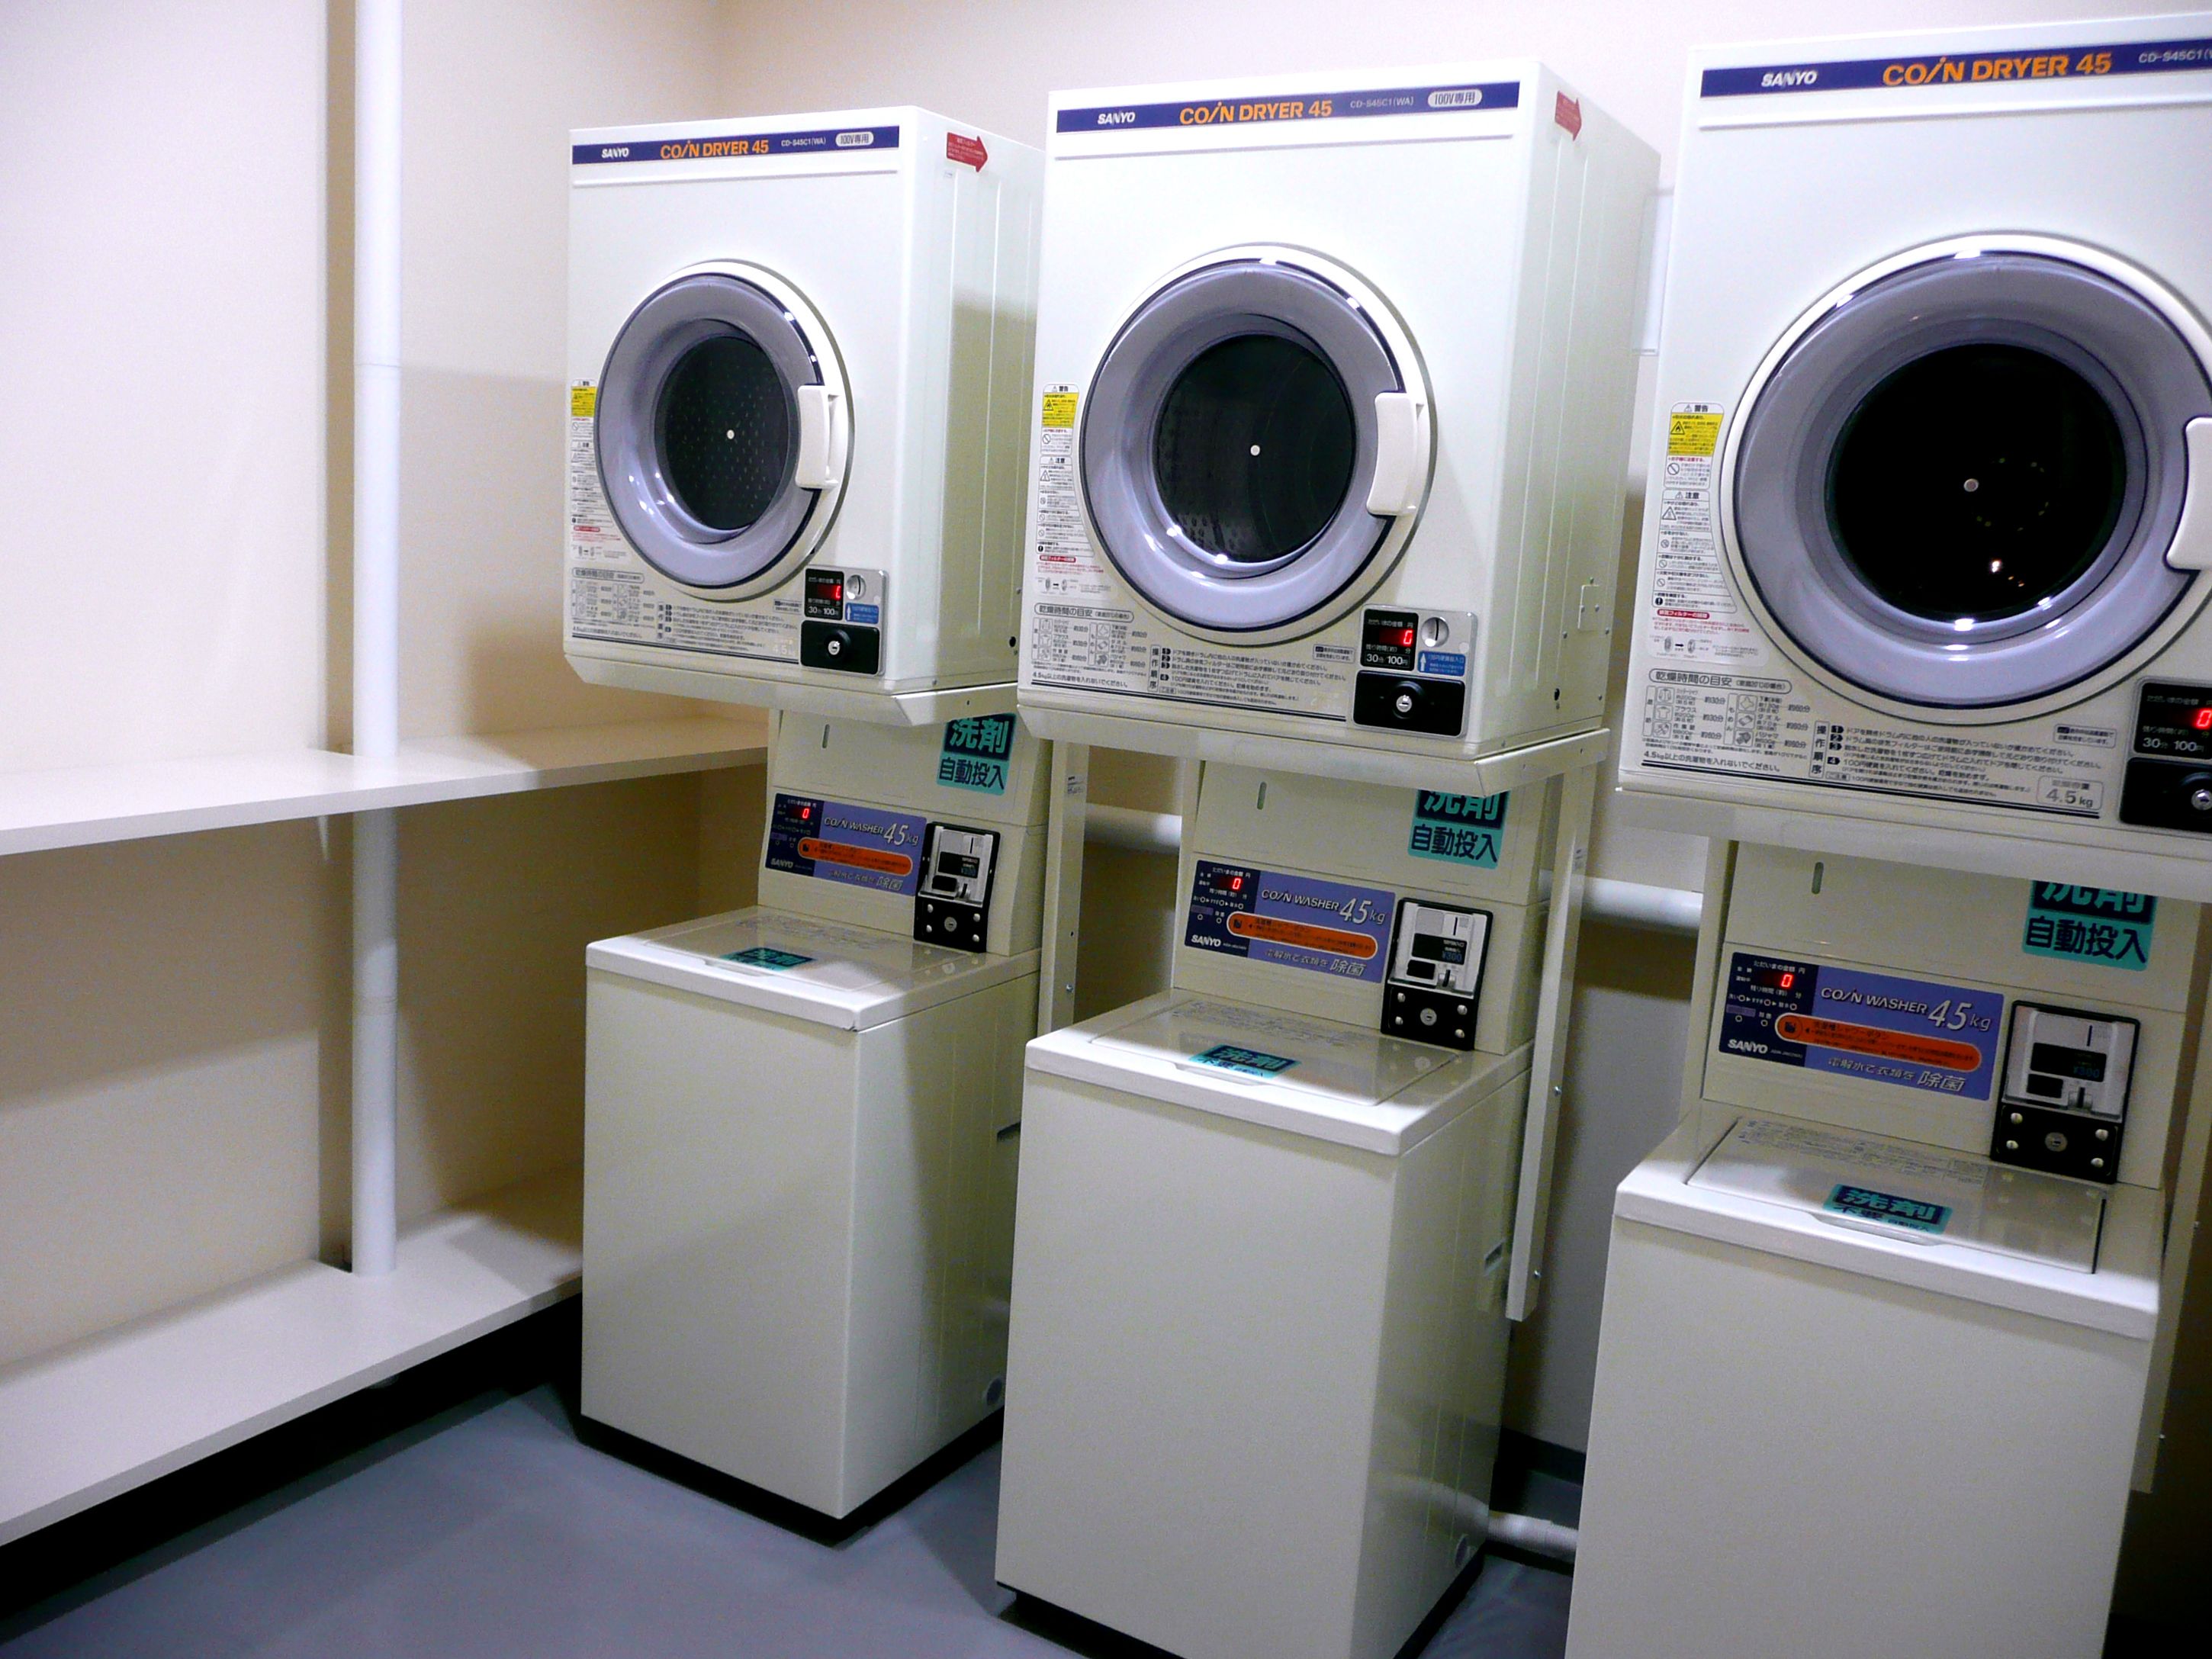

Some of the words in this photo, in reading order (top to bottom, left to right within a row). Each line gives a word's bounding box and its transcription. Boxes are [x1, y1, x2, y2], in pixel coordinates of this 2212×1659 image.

[1971, 54, 2069, 81] DRYER
[2075, 53, 2112, 75] 45
[1761, 70, 1817, 88] SANYO
[1434, 92, 1475, 105] 100V専用
[1098, 111, 1136, 125] SANYO
[1239, 102, 1304, 122] DRYER
[1308, 100, 1332, 117] 45
[601, 147, 630, 159] SANYO
[703, 140, 749, 157] DRYER
[752, 140, 770, 154] 45
[1403, 630, 1413, 645] 0
[1655, 670, 1733, 686] 乾燥時間の目安
[2197, 709, 2212, 728] 0
[950, 718, 1010, 754] 洗剤
[1811, 725, 1828, 773] 操作順序
[939, 757, 1005, 790] 自動投入
[802, 808, 810, 820] 0
[848, 821, 885, 837] WASHER
[1411, 824, 1497, 863] 自動投入
[770, 858, 794, 870] SANYO
[1232, 877, 1243, 891] 0
[1293, 895, 1340, 913] WASHER
[1191, 934, 1222, 947] SANYO
[2026, 915, 2146, 963] 自動投入
[1329, 957, 1368, 978] 除菌
[1781, 973, 1794, 989] 0
[1866, 995, 1929, 1015] WASHER
[1727, 1038, 1769, 1054] SANYO
[1917, 1070, 1968, 1092] 除菌
[1842, 1189, 1937, 1220] 洗剤
